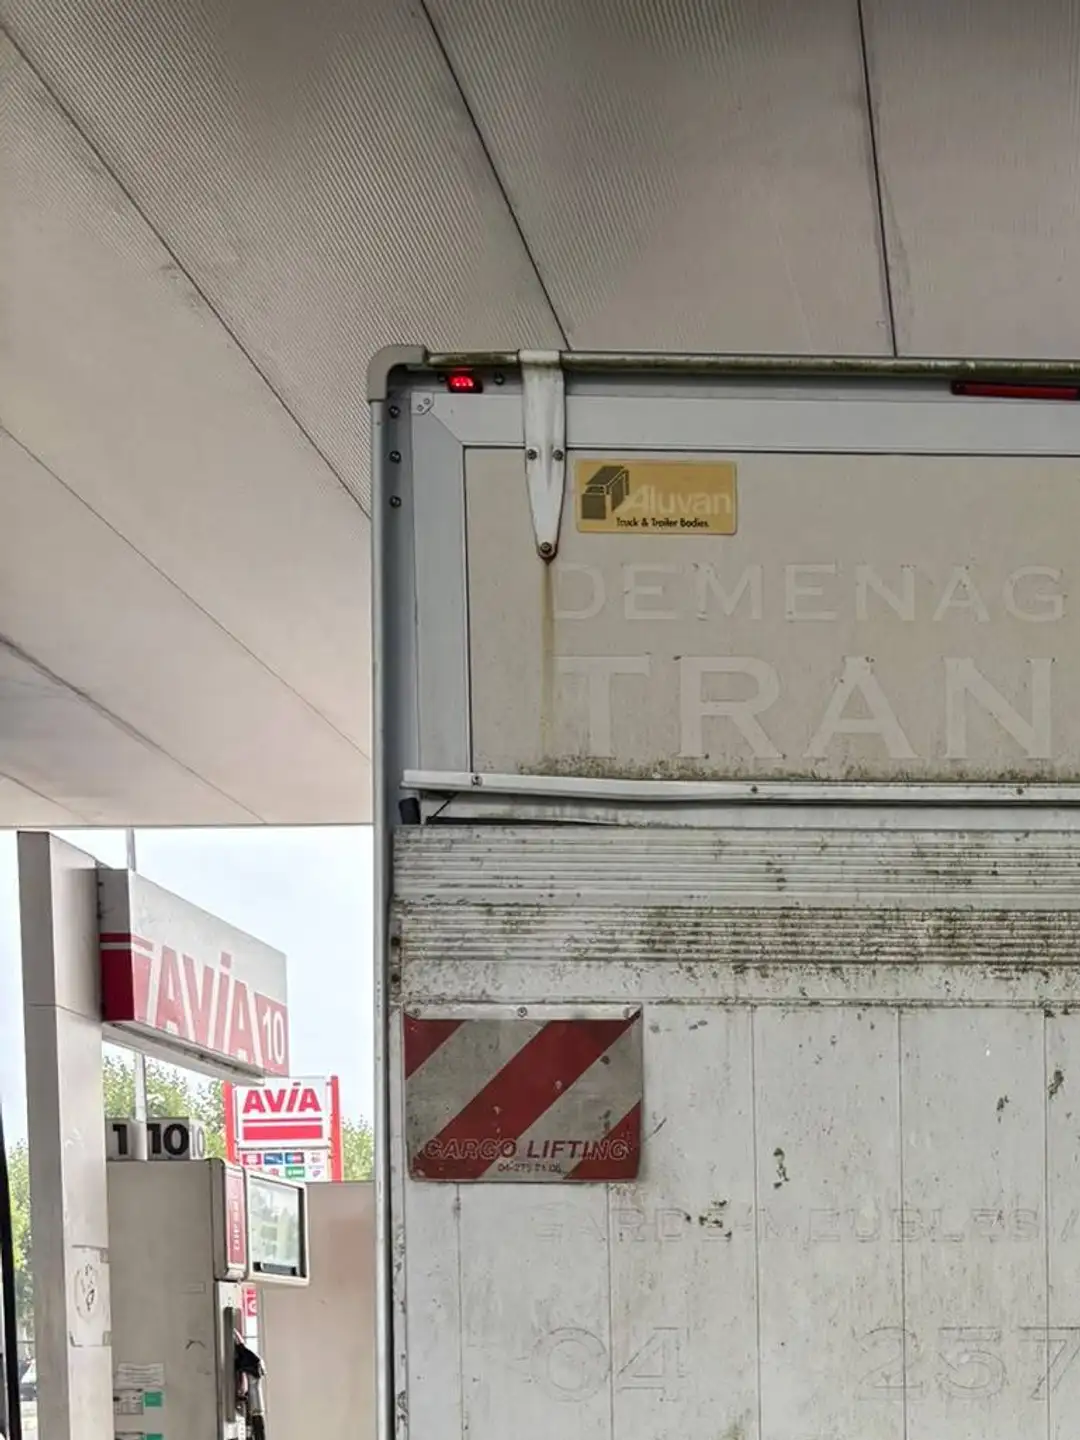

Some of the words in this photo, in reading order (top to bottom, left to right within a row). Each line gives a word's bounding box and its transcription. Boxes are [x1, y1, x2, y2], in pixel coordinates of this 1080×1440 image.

[613, 484, 731, 514] Aluvan
[616, 517, 638, 527] Truck
[641, 517, 648, 527] &
[651, 517, 677, 528] Trailer
[263, 1005, 285, 1064] 10
[242, 1082, 321, 1113] AVIA
[147, 1123, 189, 1155] 10
[424, 1138, 518, 1160] CARGO
[526, 1139, 629, 1161] LIFTING
